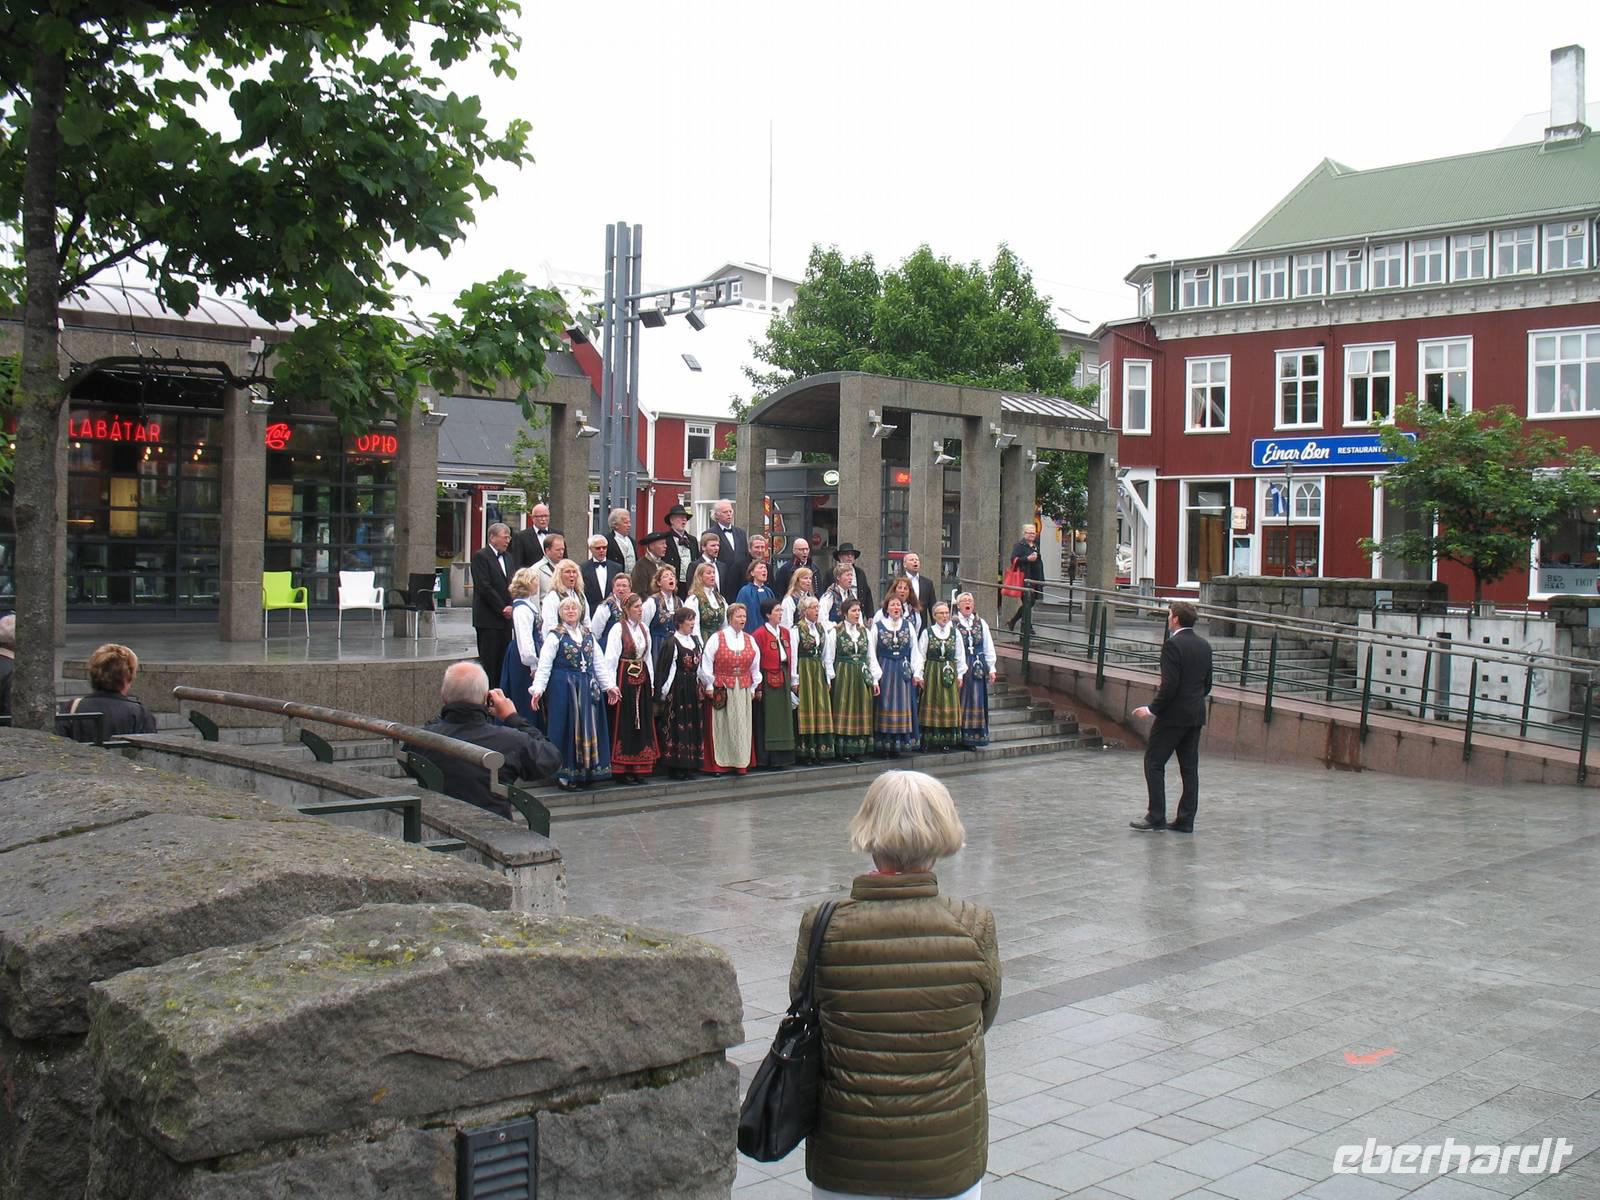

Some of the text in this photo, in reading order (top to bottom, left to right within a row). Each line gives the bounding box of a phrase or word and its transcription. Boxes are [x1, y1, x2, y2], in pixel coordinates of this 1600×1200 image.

[1262, 441, 1382, 464] Einar Ben RESTAURANT
